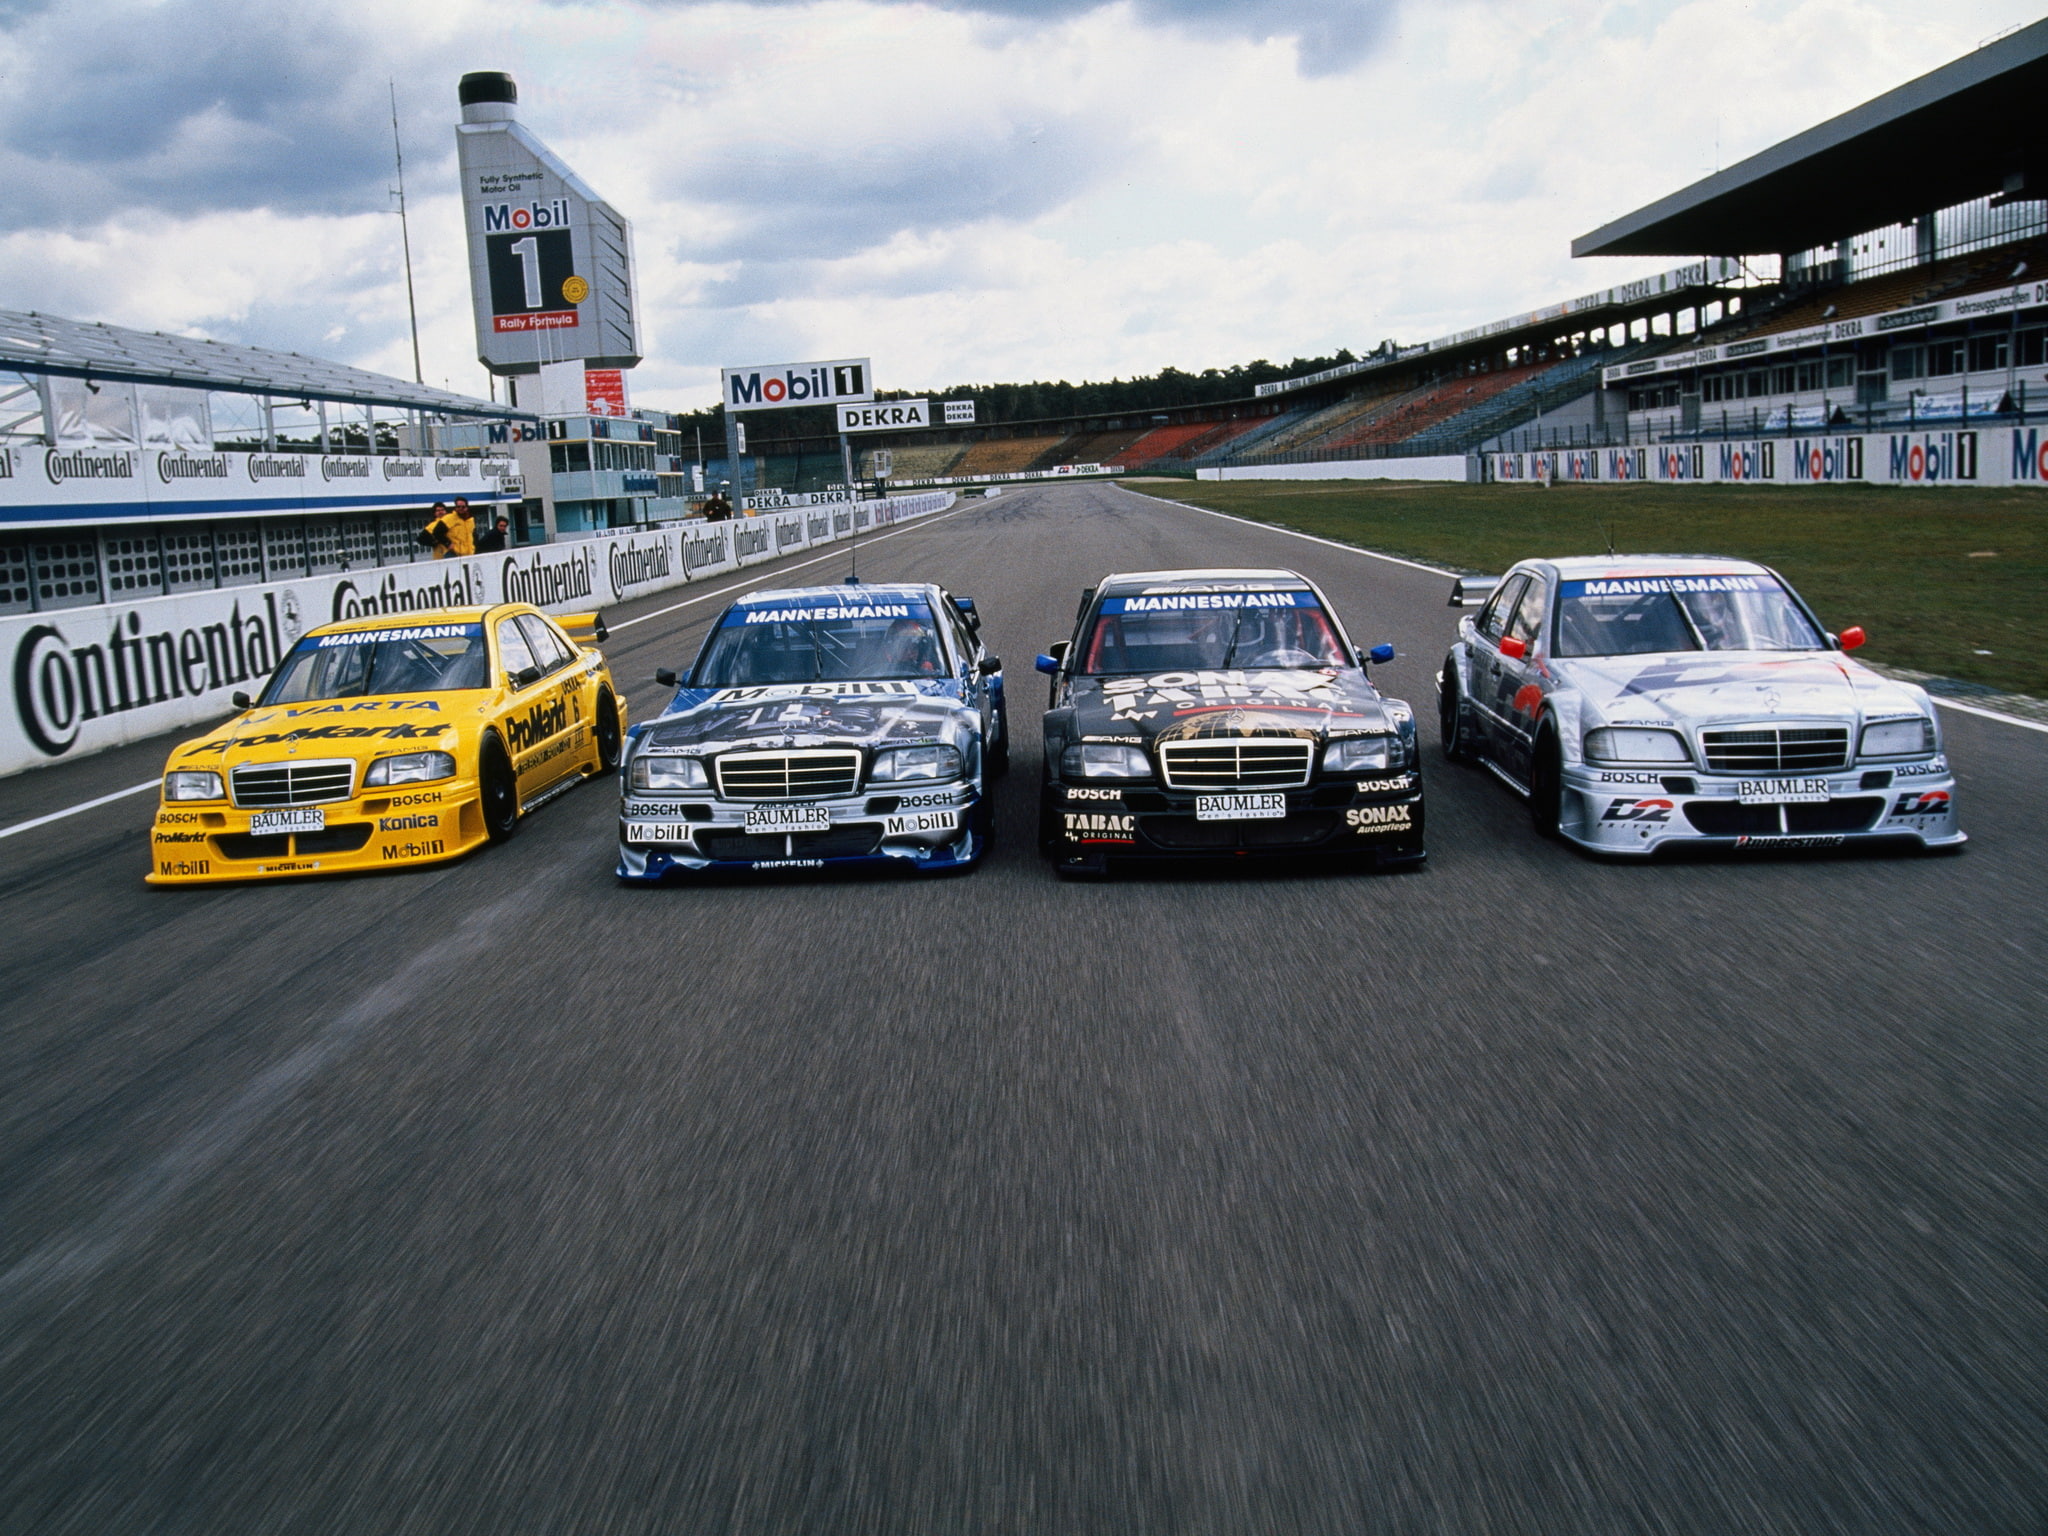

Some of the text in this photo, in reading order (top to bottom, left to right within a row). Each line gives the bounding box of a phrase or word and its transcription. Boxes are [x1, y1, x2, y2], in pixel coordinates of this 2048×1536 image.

[480, 171, 544, 185] Fully Synthetic
[481, 183, 521, 194] Motor Oil
[483, 199, 570, 232] Mobil
[511, 236, 543, 309] 1
[1676, 261, 1705, 288] DEKRA
[1622, 278, 1650, 303] DEKRA
[500, 314, 573, 329] Rally Formula
[1835, 320, 1863, 339] DEKRA
[731, 367, 829, 404] Mobil
[846, 406, 922, 427] DEKRA
[946, 404, 973, 412] DEKRA
[488, 422, 547, 444] Mobil
[1609, 449, 1637, 480] Mobil
[1659, 446, 1691, 479] Mobil
[1720, 442, 1759, 480] Mobil
[1795, 438, 1844, 480] Mobil
[1890, 432, 1953, 481] Mobil
[45, 448, 133, 485] Continental
[158, 451, 228, 484] Continental
[249, 454, 305, 483] Continental
[321, 455, 370, 482] Continental
[383, 457, 424, 482] Continental
[435, 458, 470, 481] Continental
[1024, 471, 1043, 479] DEKRA
[1081, 465, 1099, 473] DEKRA
[952, 475, 974, 483] DEKRA
[747, 495, 791, 508] DEKRA
[755, 488, 778, 497] DEKRA
[811, 490, 850, 504] DEKR
[734, 518, 769, 566] Continental
[681, 526, 727, 581] Continental
[502, 545, 593, 606] Continental
[609, 538, 669, 600] Continental
[1585, 577, 1758, 595] MANNESMANN
[1124, 593, 1296, 612] MANNESMANN
[746, 604, 909, 624] MANNESMANN
[318, 625, 467, 647] MANNESMANN
[14, 592, 282, 757] Continental
[1103, 670, 1345, 695] SONAX
[719, 683, 862, 701] Mobil
[286, 700, 441, 718] VARTA
[1176, 698, 1355, 713] ORIGINAL
[505, 695, 566, 753] ProMarkt
[182, 722, 452, 758] ProMarkt
[1601, 772, 1659, 784] BOSCH
[1895, 764, 1944, 777] BOSCH
[1067, 788, 1121, 800] BOSCH
[1357, 777, 1409, 793] BOSCH
[393, 791, 442, 807] BOSCH
[901, 793, 953, 808] BOSCH
[1198, 794, 1284, 812] BÄUMLER
[1891, 790, 1951, 816] D2
[160, 812, 198, 824] BOSCH
[631, 803, 680, 815] BOSCH
[747, 807, 828, 826] BÄUMLER
[1346, 804, 1411, 826] SONAX
[1601, 798, 1674, 822] D2
[379, 813, 439, 832] Konica
[888, 812, 940, 834] Mobil
[1064, 813, 1135, 831] TABAC
[1357, 822, 1412, 834] Autopflege
[155, 831, 207, 844] ProMarkt
[630, 824, 675, 841] Mobil
[1083, 831, 1134, 840] ORIGINAL
[382, 841, 431, 860] Mobil
[161, 860, 198, 876] Mobil
[266, 863, 313, 872] MICHELIN
[761, 859, 815, 869] MICHELIN
